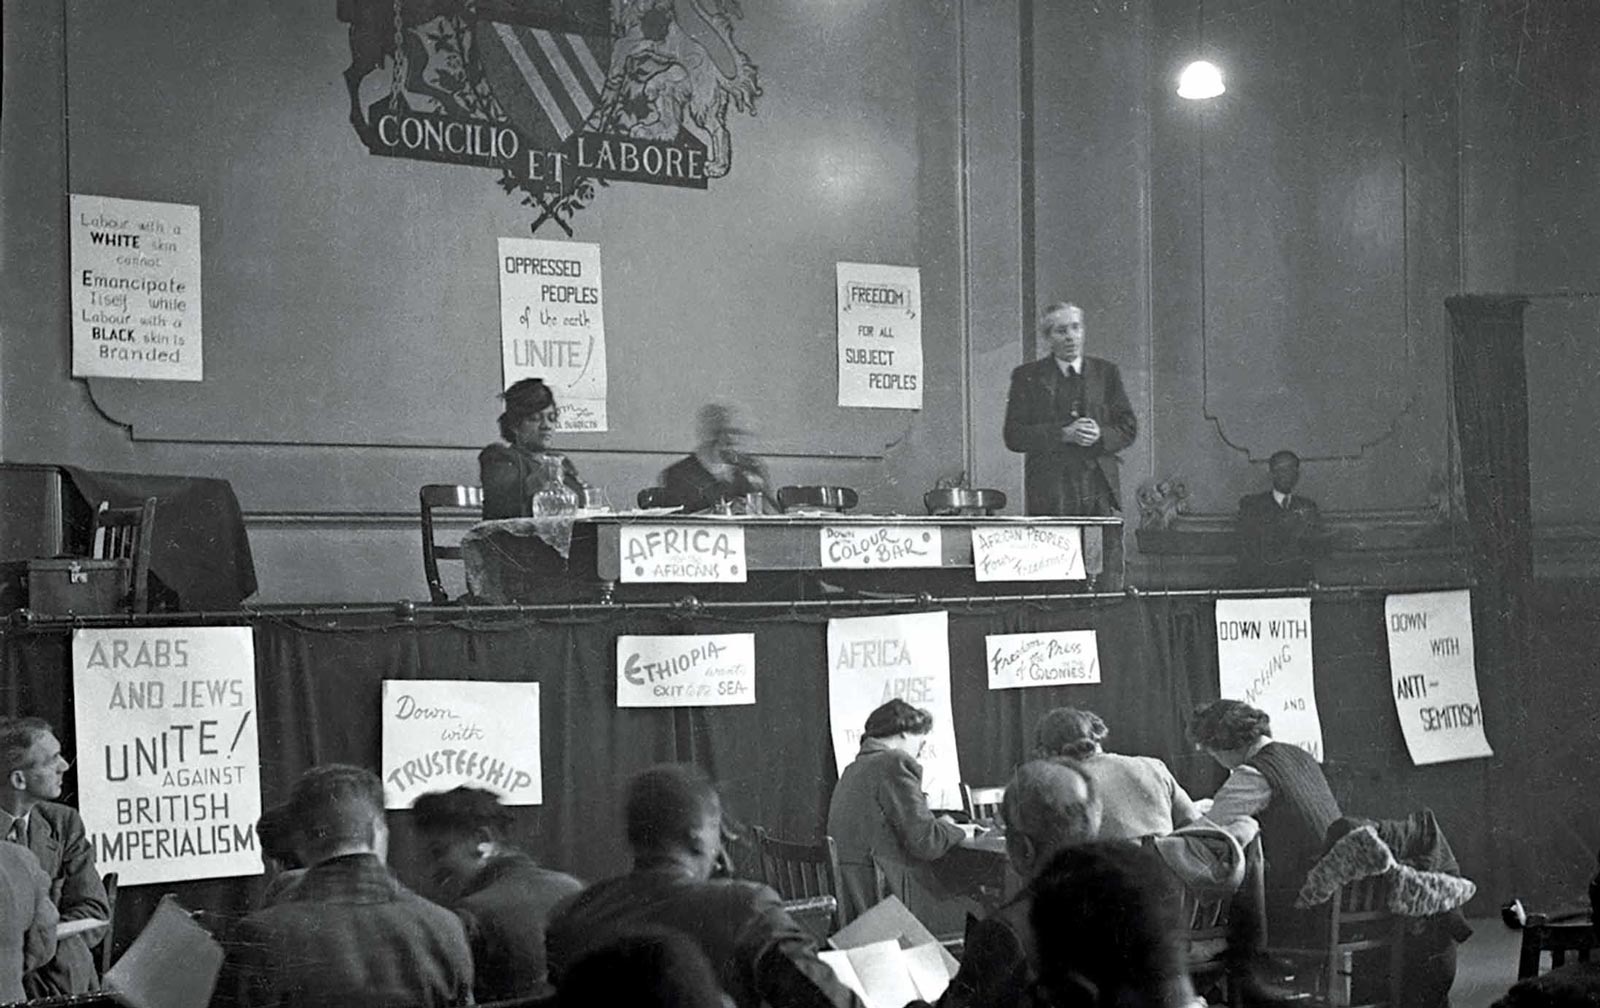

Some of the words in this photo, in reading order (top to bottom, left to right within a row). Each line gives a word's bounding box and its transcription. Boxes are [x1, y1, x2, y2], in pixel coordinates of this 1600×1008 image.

[379, 114, 519, 159] CONCILIO
[529, 150, 570, 183] ET
[578, 137, 703, 180] LABORE
[90, 231, 140, 249] WHITE
[173, 226, 181, 234] a
[505, 256, 582, 278] OPPRESSED
[82, 270, 187, 295] Emancipate
[148, 297, 187, 312] while
[541, 284, 598, 305] PEOPLES
[852, 286, 903, 306] FREEDOM
[82, 309, 131, 325] Labour
[173, 320, 182, 328] a
[519, 305, 531, 329] of
[92, 326, 135, 343] BLACK
[858, 325, 874, 337] FOR
[880, 326, 895, 338] ALL
[100, 344, 180, 363] Branded
[846, 348, 895, 366] SUBJECT
[869, 373, 917, 390] PEOPLES
[624, 528, 737, 564] AFRICA
[876, 538, 928, 562] BAR
[654, 563, 720, 579] AFRICANS
[1220, 620, 1261, 641] DOWN
[1269, 620, 1308, 640] WITH
[1391, 612, 1427, 632] DOWN
[87, 639, 189, 670] ARABS
[836, 639, 912, 670] AFRICA
[1430, 636, 1460, 657] WITH
[109, 680, 164, 710] AND
[172, 679, 244, 709] JEWS
[718, 680, 749, 696] SEA
[881, 676, 935, 704] ARISE
[395, 695, 461, 720] Down
[1283, 698, 1306, 711] AND
[1420, 703, 1481, 732] SEMITISM
[441, 723, 485, 741] with
[105, 710, 252, 782] UNITE!
[162, 766, 246, 788] AGAINST
[117, 792, 230, 826] BRITISH
[92, 823, 255, 864] IMPERIALISM
